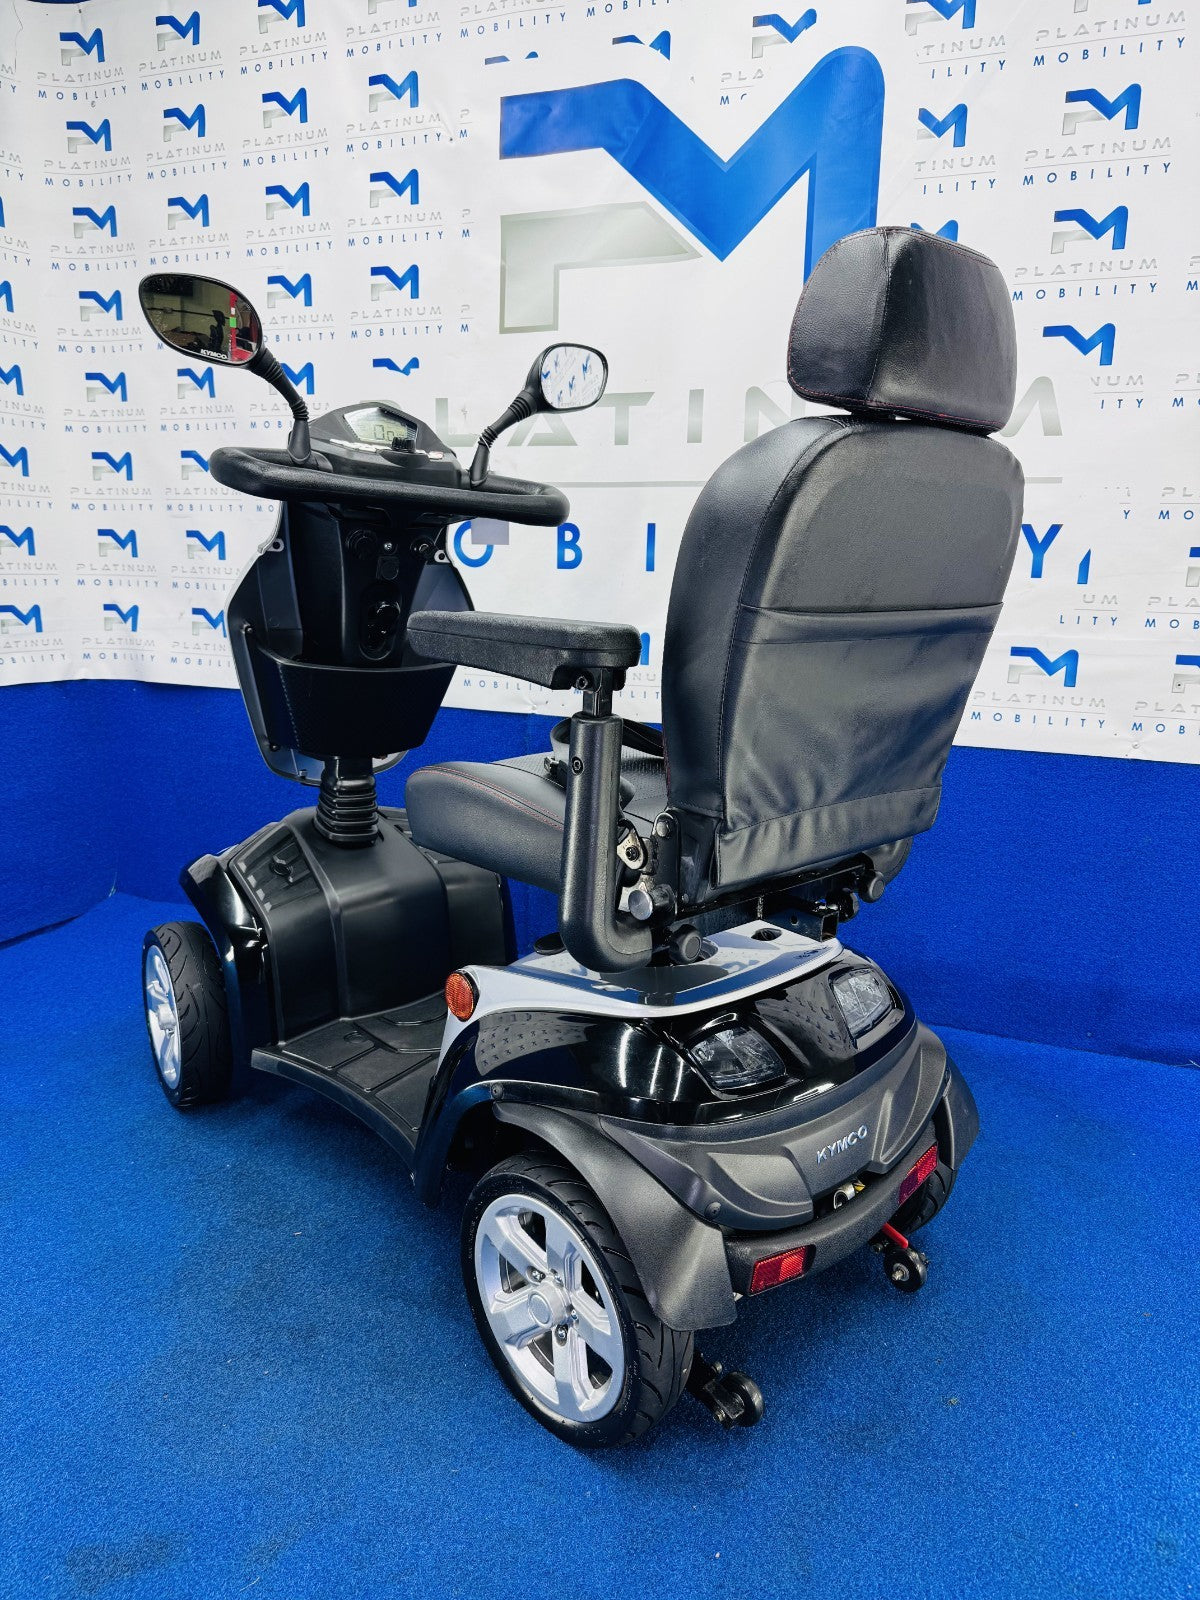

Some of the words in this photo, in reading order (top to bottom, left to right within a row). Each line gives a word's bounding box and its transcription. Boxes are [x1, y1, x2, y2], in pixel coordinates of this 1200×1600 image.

[346, 11, 441, 37] PLATINUM
[460, 12, 566, 38] MOBILITY
[1035, 10, 1186, 42] PLATINUM
[240, 32, 327, 55] PLATINUM
[346, 33, 442, 58] MOBILITY
[1033, 36, 1186, 67] MOBILITY
[138, 50, 222, 72] PLATINUM
[240, 51, 328, 74] MOBILITY
[37, 67, 124, 82] PLATINUM
[141, 69, 225, 91] MOBILITY
[38, 85, 127, 100] MOBILITY
[346, 113, 441, 134] PLATINUM
[242, 127, 328, 148] PLATINUM
[346, 132, 442, 153] MOBILITY
[146, 142, 225, 162] PLATINUM
[243, 147, 329, 167] MOBILITY
[1024, 136, 1172, 162] PLATINUM
[43, 156, 130, 171] PLATINUM
[147, 161, 228, 181] MOBILITY
[45, 173, 133, 187] MOBILITY
[1023, 162, 1171, 186] MOBILITY
[347, 211, 442, 228] PLATINUM
[246, 221, 331, 239] PLATINUM
[149, 232, 229, 248] PLATINUM
[348, 230, 443, 248] MOBILITY
[51, 243, 136, 254] PLATINUM
[246, 240, 332, 257] MOBILITY
[51, 259, 138, 272] MOBILITY
[150, 251, 231, 266] MOBILITY
[1014, 257, 1158, 278] PLATINUM
[1012, 281, 1158, 302] MOBILITY
[350, 305, 442, 320] PLATINUM
[56, 327, 141, 337] PLATINUM
[351, 324, 443, 339] MOBILITY
[58, 343, 143, 354] MOBILITY
[200, 349, 229, 359] KYMCO
[63, 407, 145, 418] PLATINUM
[159, 404, 235, 415] PLATINUM
[65, 424, 147, 434] MOBILITY
[160, 422, 238, 433] MOBILITY
[70, 486, 152, 496] PLATINUM
[72, 502, 154, 512] MOBILITY
[166, 503, 243, 512] MOBILITY
[76, 562, 157, 573] PLATINUM
[77, 577, 160, 588] MOBILITY
[81, 636, 156, 648] PLATINUM
[83, 651, 156, 663] MOBILITY
[972, 690, 1106, 709] PLATINUM
[971, 710, 1106, 729] MOBILITY
[815, 1124, 868, 1165] KYMCO
